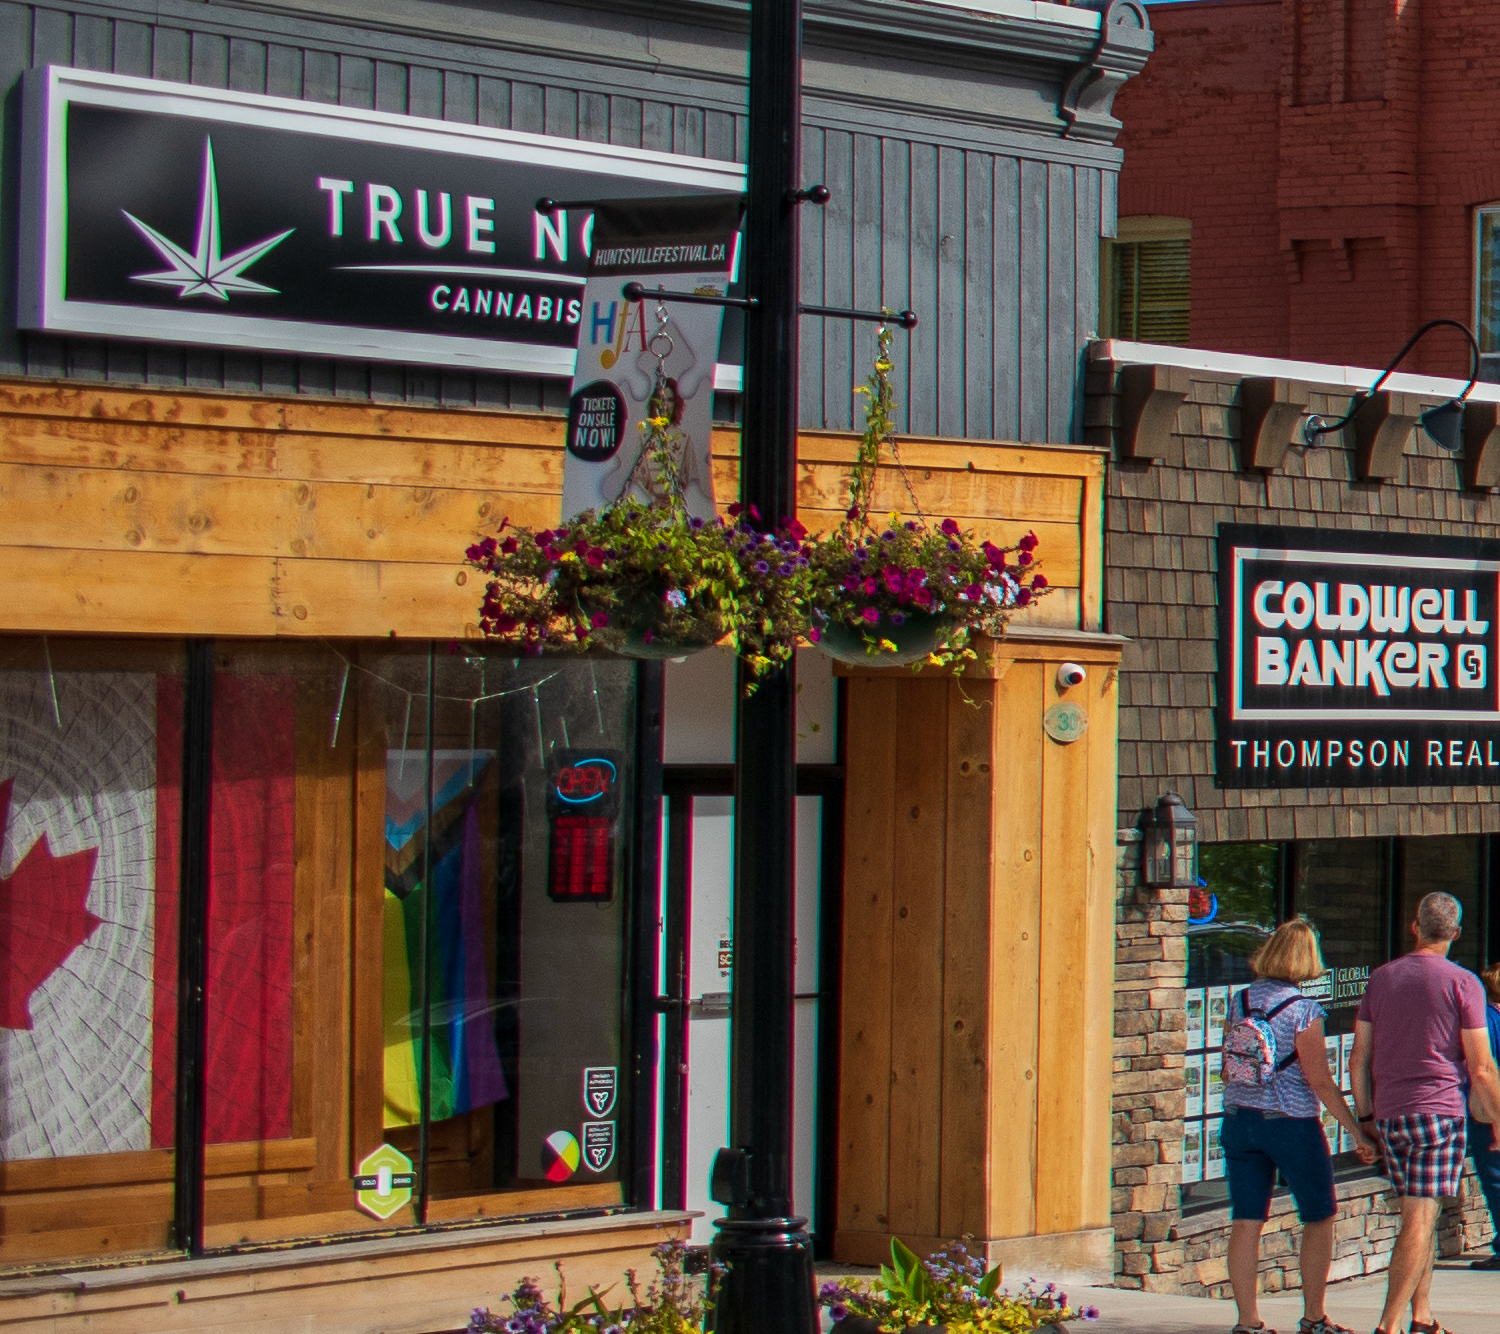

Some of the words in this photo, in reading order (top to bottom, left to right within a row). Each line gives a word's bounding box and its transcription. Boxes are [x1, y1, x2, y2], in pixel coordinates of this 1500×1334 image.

[317, 176, 495, 253] TRUE
[594, 243, 726, 266] HUNTSVILLEFESTIVAL.CA
[430, 285, 581, 324] CANNABIS
[581, 397, 616, 413] TICKETS
[575, 428, 616, 448] NOW!
[1253, 580, 1489, 635] COLDWELL
[1255, 636, 1449, 696] BANKER
[1057, 712, 1077, 732] 30
[1230, 739, 1410, 768] THOMPSON
[1426, 739, 1500, 767] REAL
[556, 767, 611, 794] OPEN
